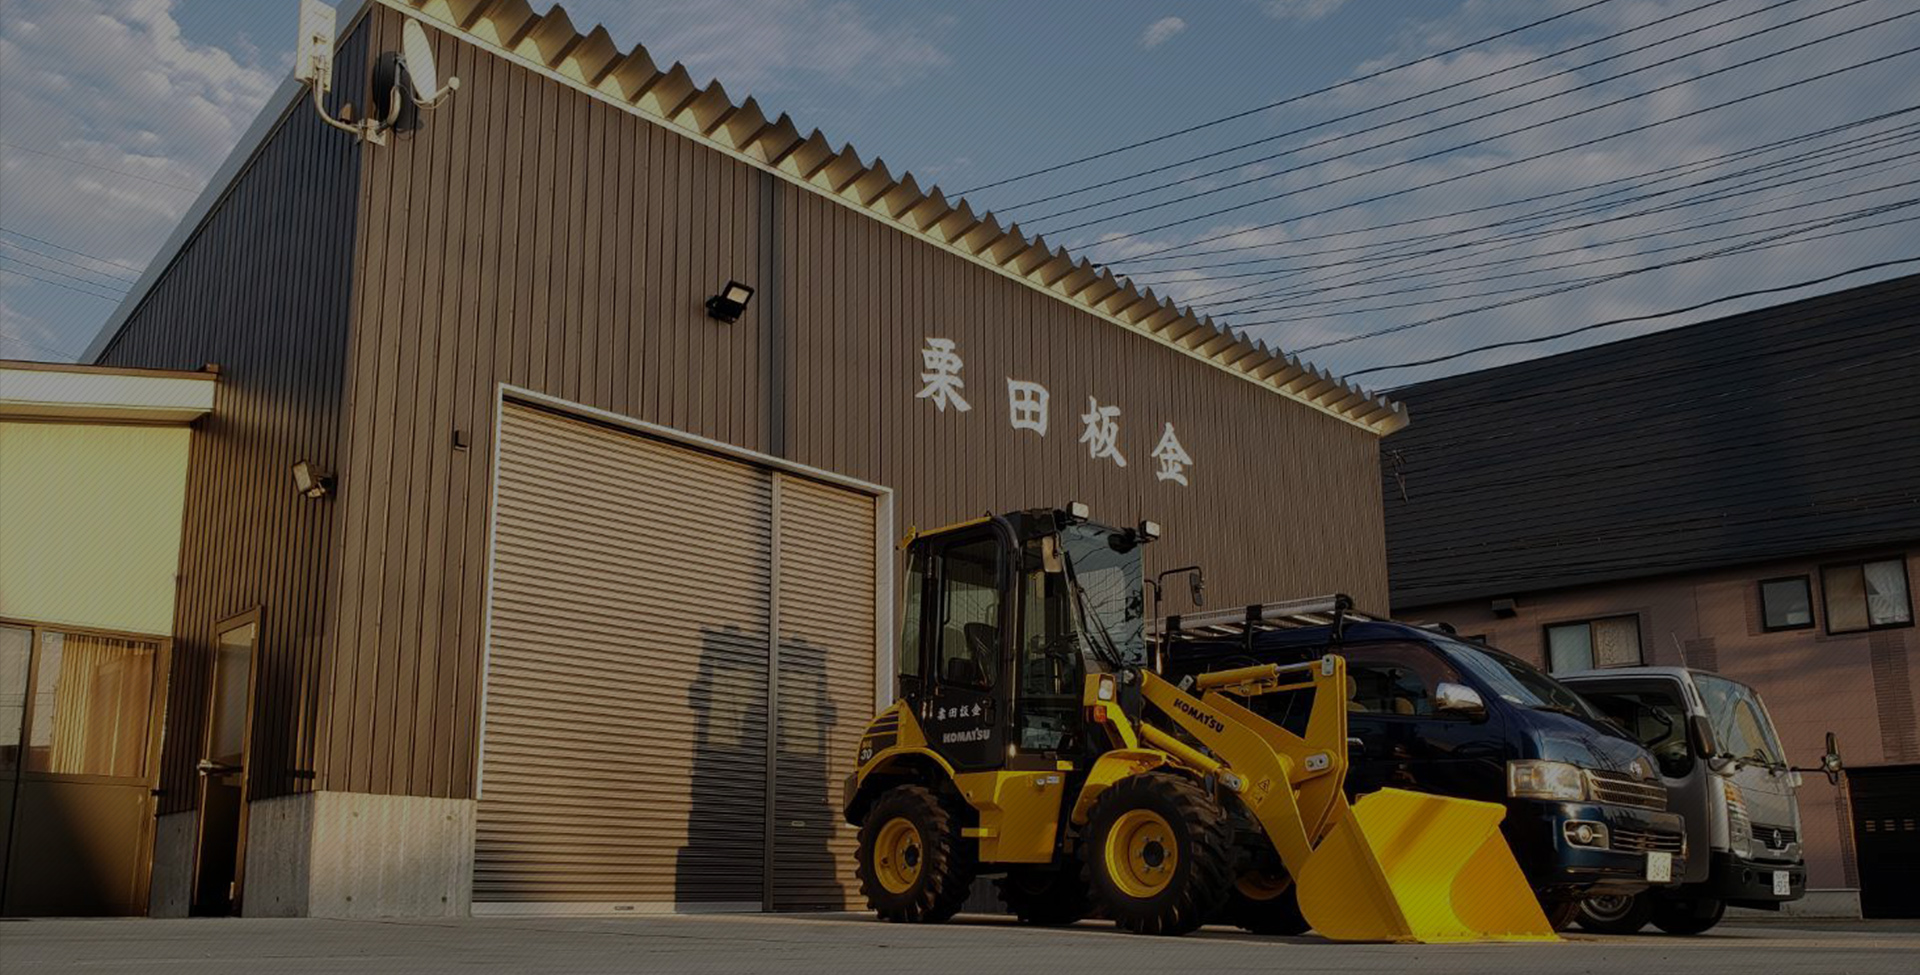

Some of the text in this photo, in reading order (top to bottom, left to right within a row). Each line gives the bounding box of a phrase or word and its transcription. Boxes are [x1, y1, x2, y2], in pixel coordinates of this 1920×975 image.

[915, 337, 1193, 487] 栗田板金
[1173, 698, 1225, 733] KOMATSU
[942, 727, 991, 744] KOMATSU
